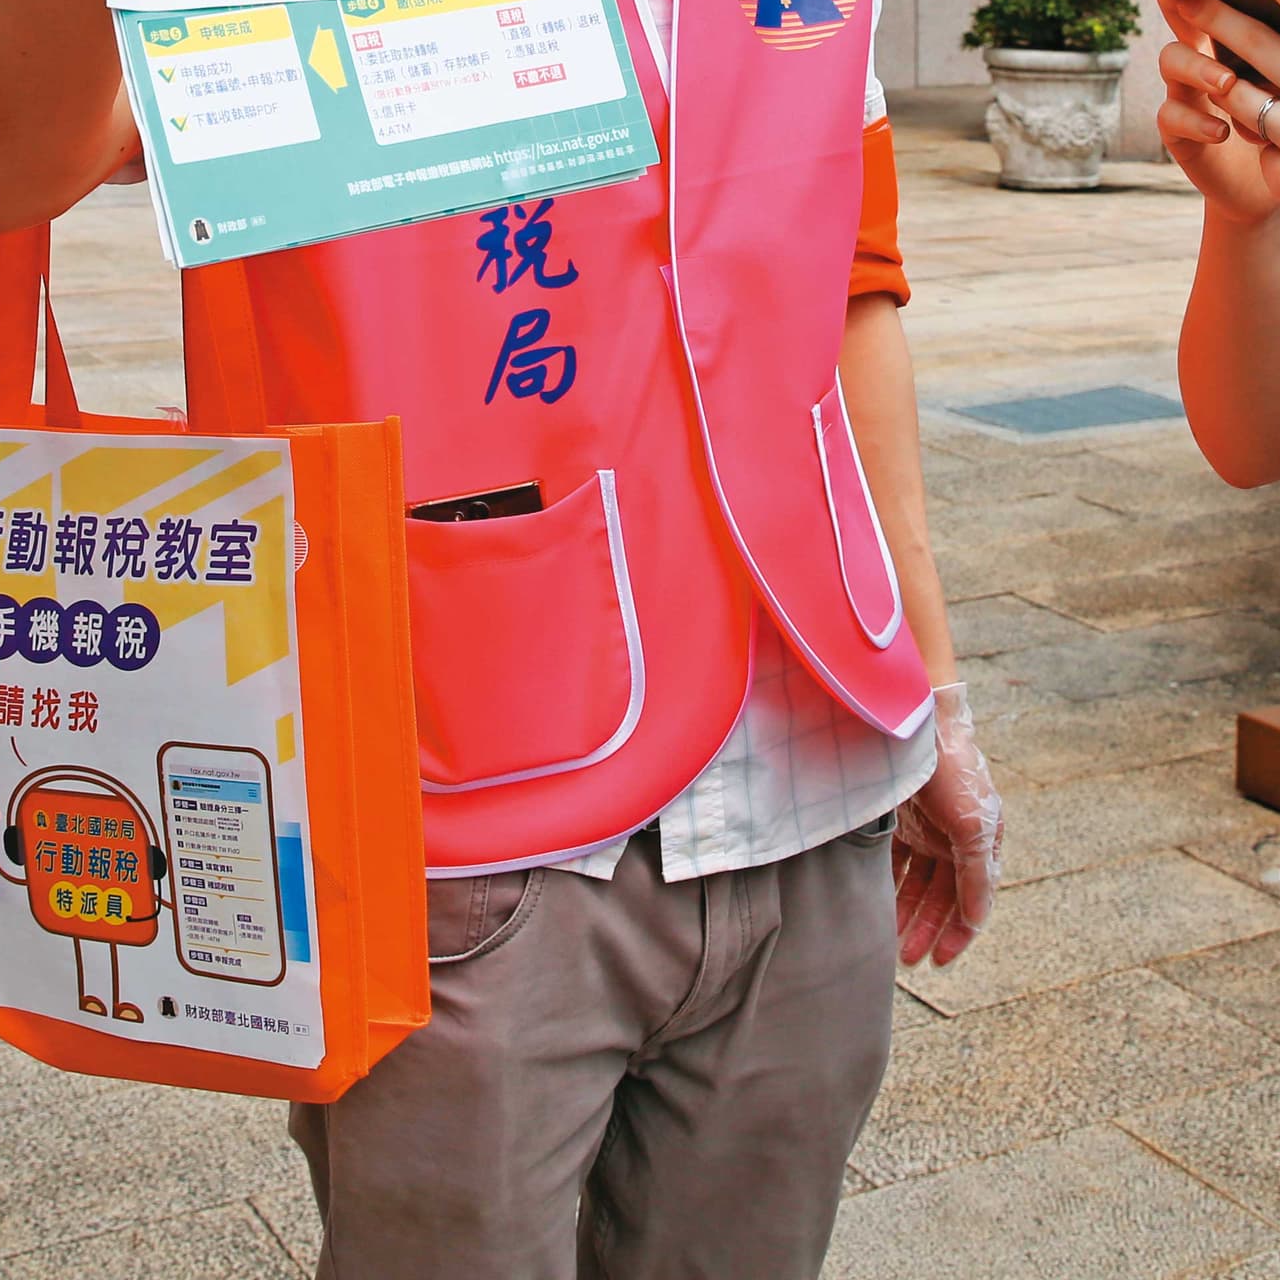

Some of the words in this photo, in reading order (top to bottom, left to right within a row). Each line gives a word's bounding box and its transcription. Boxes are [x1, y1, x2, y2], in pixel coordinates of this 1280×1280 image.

[200, 20, 252, 41] 申報完成
[180, 60, 233, 79] 申報成功
[494, 126, 630, 165] https://tax.nat.gov.tw
[190, 767, 241, 779] tax.nat.gov.tw
[55, 812, 135, 841] 臺北國稅局
[35, 840, 139, 883] 行動報稅
[56, 888, 123, 919] 特派員
[184, 1003, 290, 1035] 財政部臺北國稅局
